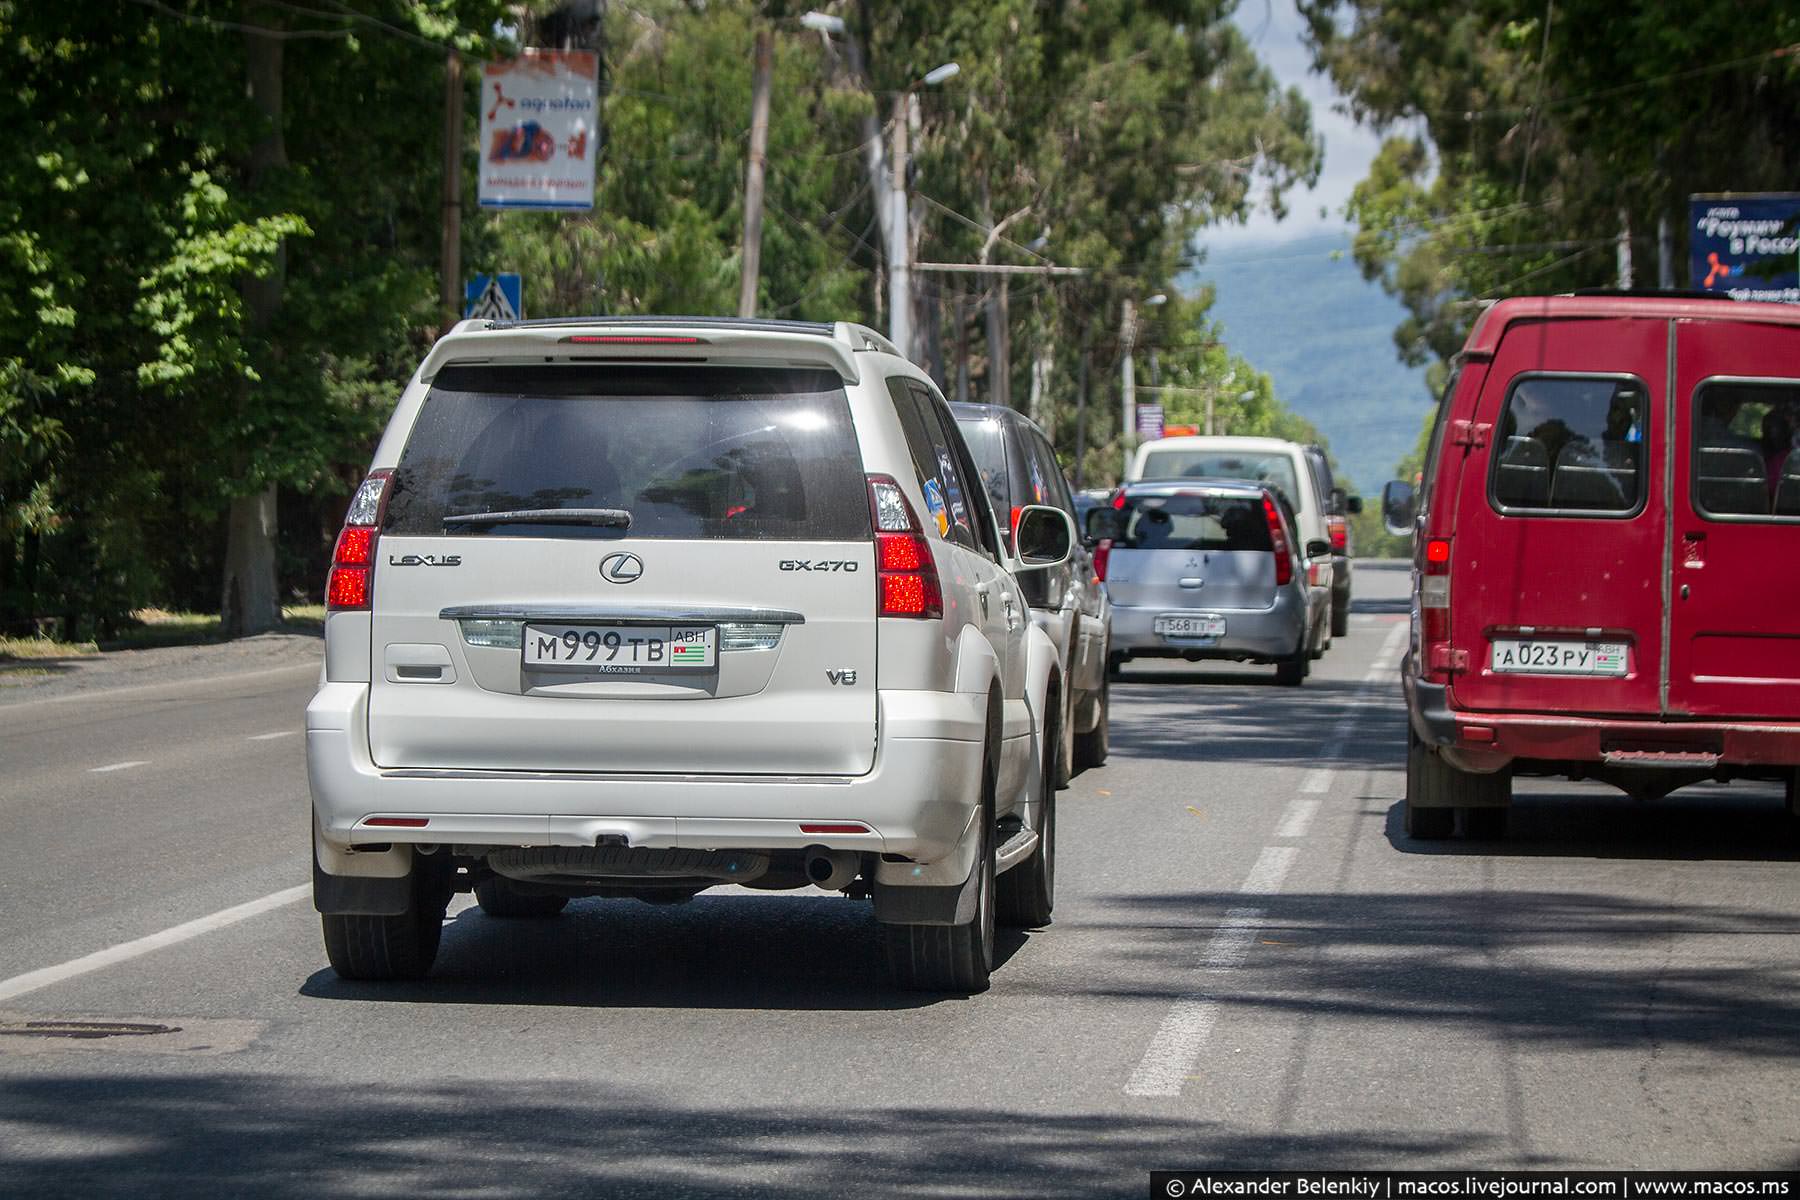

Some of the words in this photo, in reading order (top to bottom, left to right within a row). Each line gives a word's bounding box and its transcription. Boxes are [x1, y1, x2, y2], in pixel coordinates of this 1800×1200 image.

[389, 555, 462, 567] LEXUS
[674, 631, 705, 643] ABH
[825, 668, 857, 686] V8
